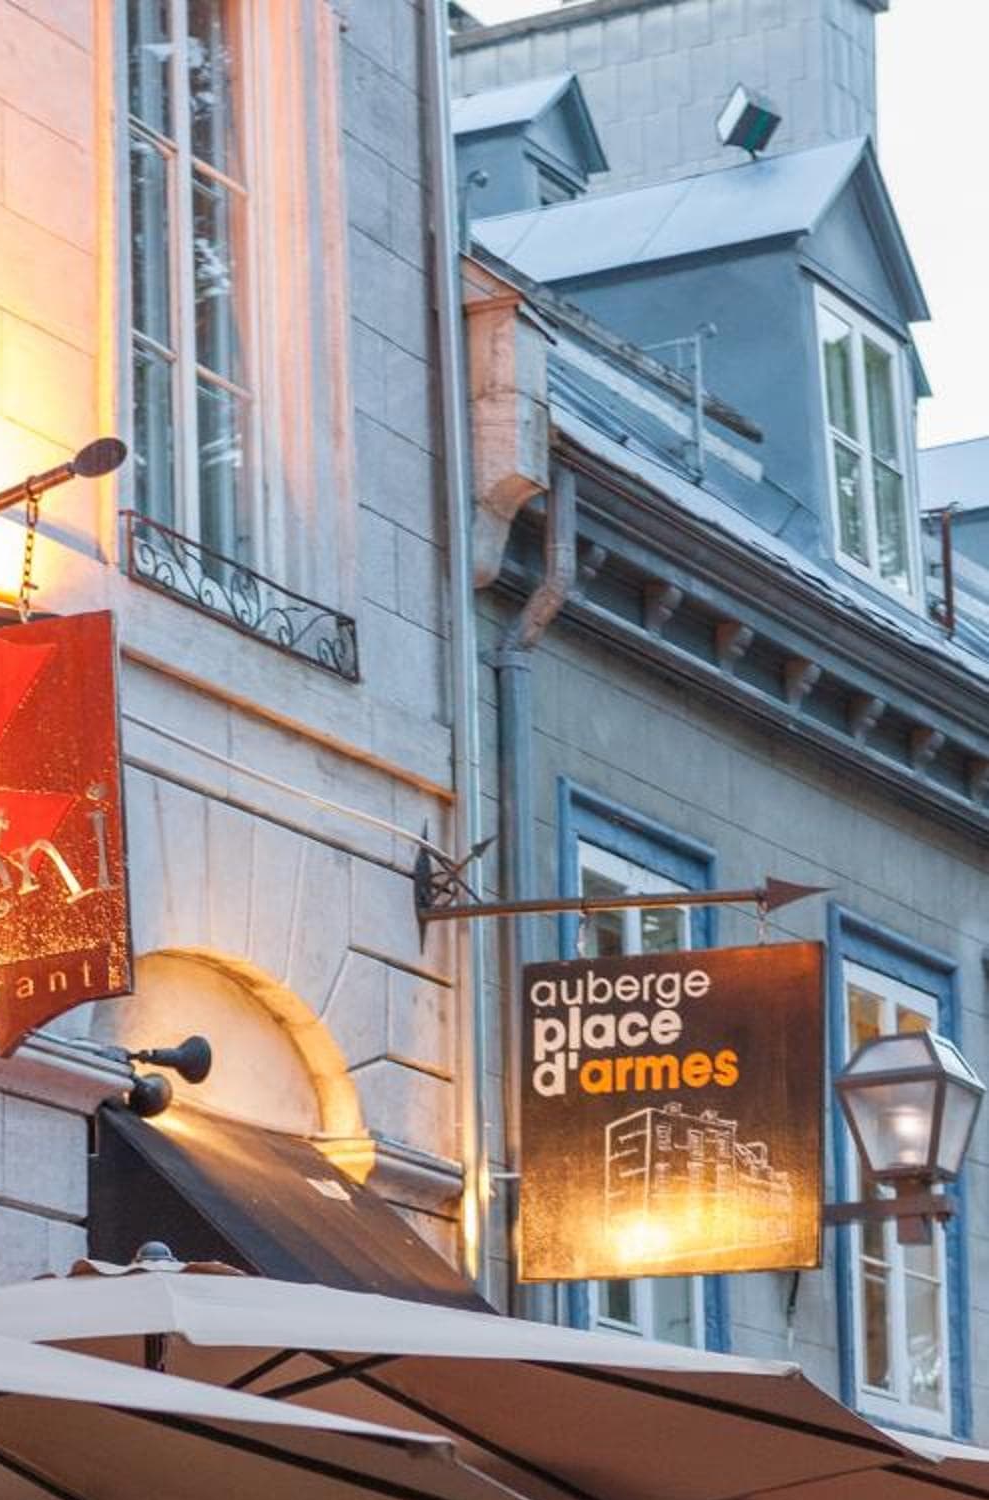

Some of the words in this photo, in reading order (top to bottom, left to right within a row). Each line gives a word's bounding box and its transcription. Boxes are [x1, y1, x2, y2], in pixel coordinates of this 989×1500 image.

[531, 970, 710, 1008] auberge
[533, 1006, 683, 1061] place
[532, 1049, 739, 1097] d'armes
